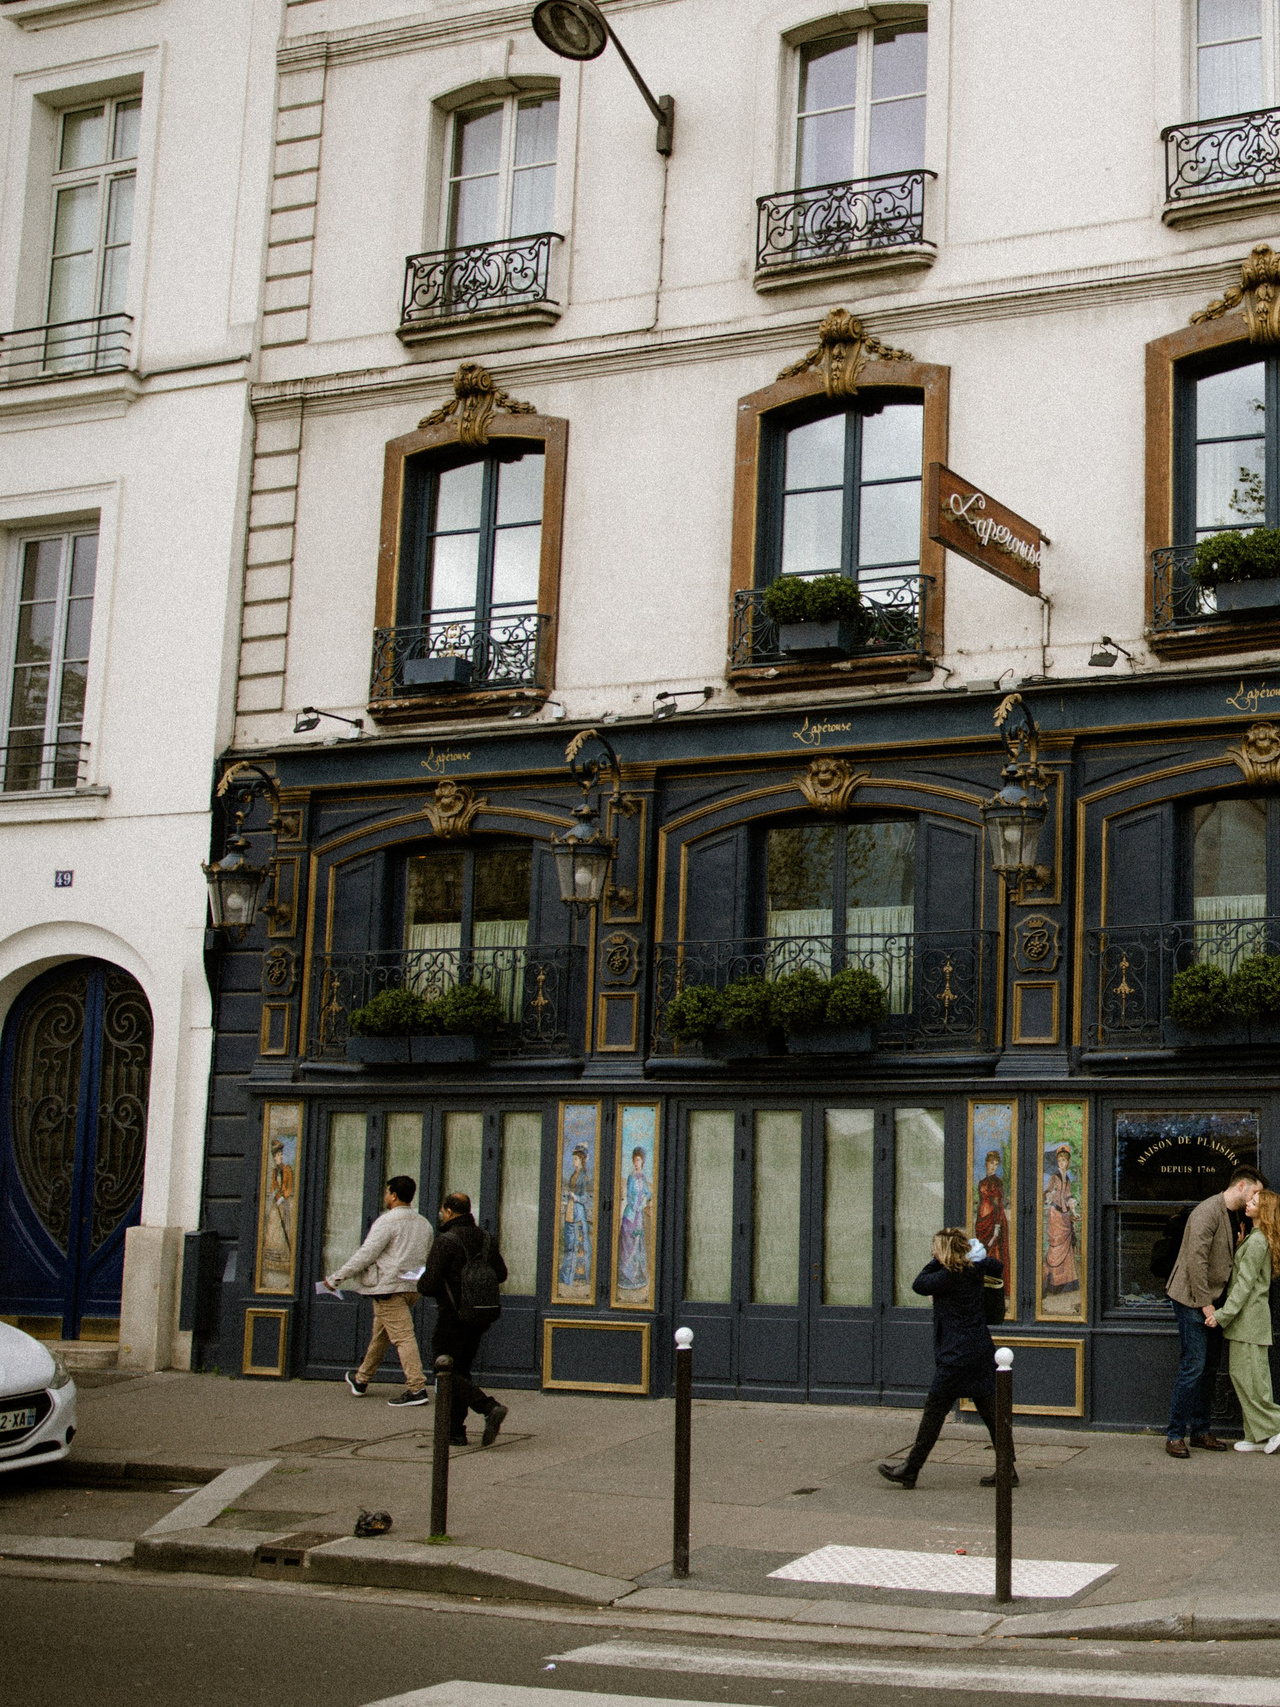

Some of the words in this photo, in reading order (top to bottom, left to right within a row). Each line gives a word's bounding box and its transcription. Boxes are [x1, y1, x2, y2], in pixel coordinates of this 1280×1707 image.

[792, 716, 852, 746] Lapérouse
[420, 746, 472, 773] Lapérouse
[56, 872, 71, 886] 49
[1137, 1138, 1173, 1166] MAISON
[1177, 1135, 1192, 1145] DE
[1196, 1136, 1240, 1167] PLAISIRS
[1160, 1165, 1193, 1173] DEPUIS
[1196, 1165, 1216, 1173] 1766
